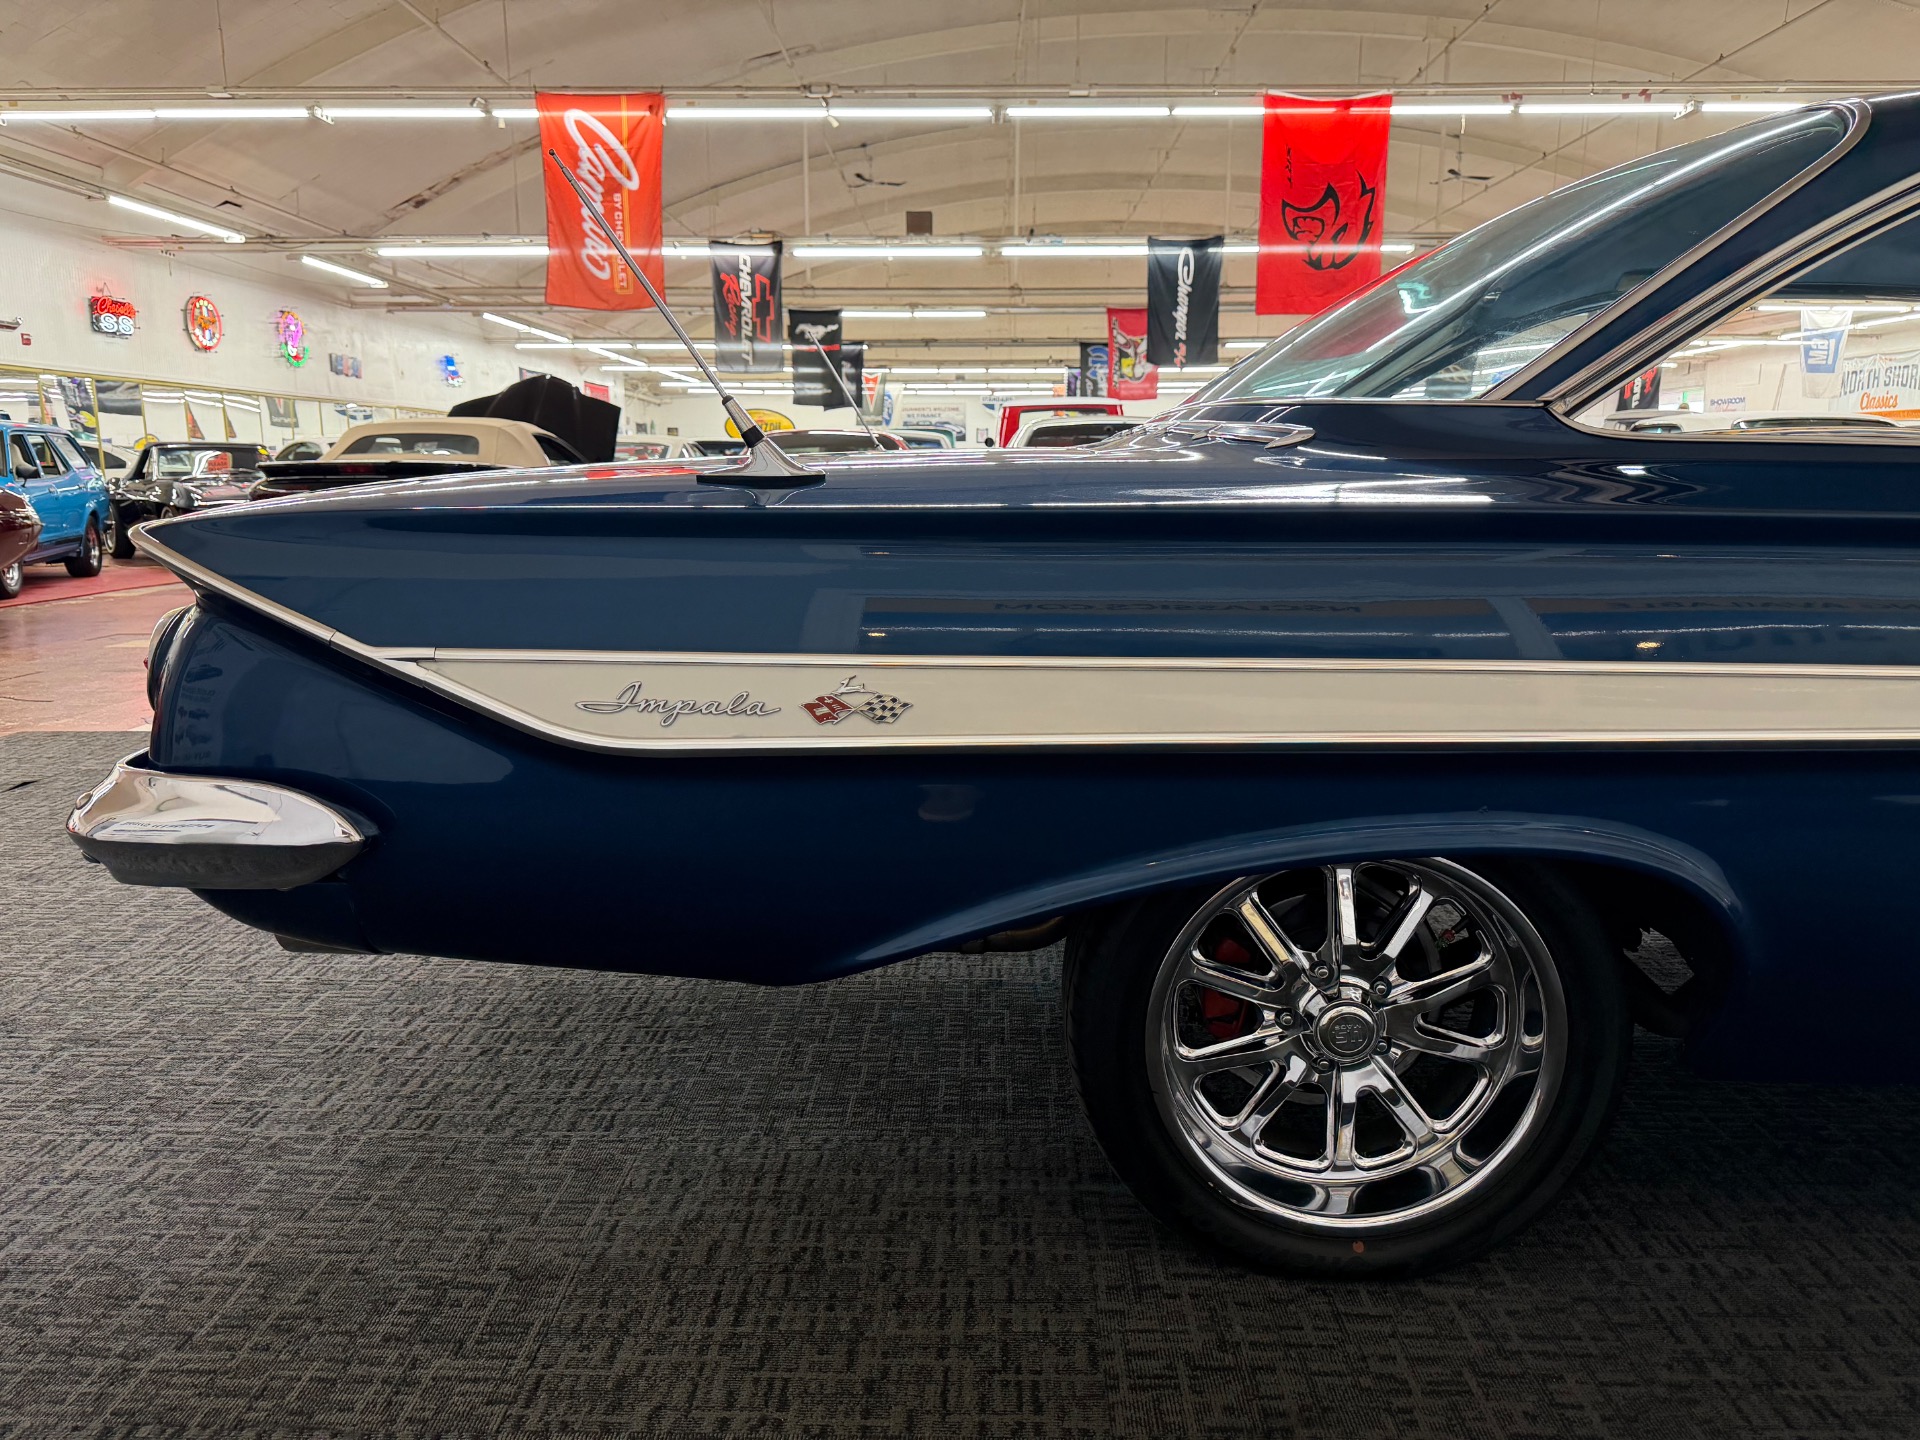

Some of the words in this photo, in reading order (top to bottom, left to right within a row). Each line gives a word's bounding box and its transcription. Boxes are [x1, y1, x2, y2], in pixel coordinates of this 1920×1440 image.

[564, 108, 639, 280] Camaro
[612, 192, 622, 209] BY
[720, 272, 742, 340] Racing
[739, 254, 753, 366] CHEVROLET
[1172, 247, 1194, 341] Charger
[100, 313, 135, 335] SS
[1840, 368, 1880, 396] NORTH
[1883, 364, 1920, 391] SHOR
[1710, 397, 1745, 406] SHOWROOM
[1859, 391, 1899, 411] Classics
[575, 680, 781, 727] Impala
